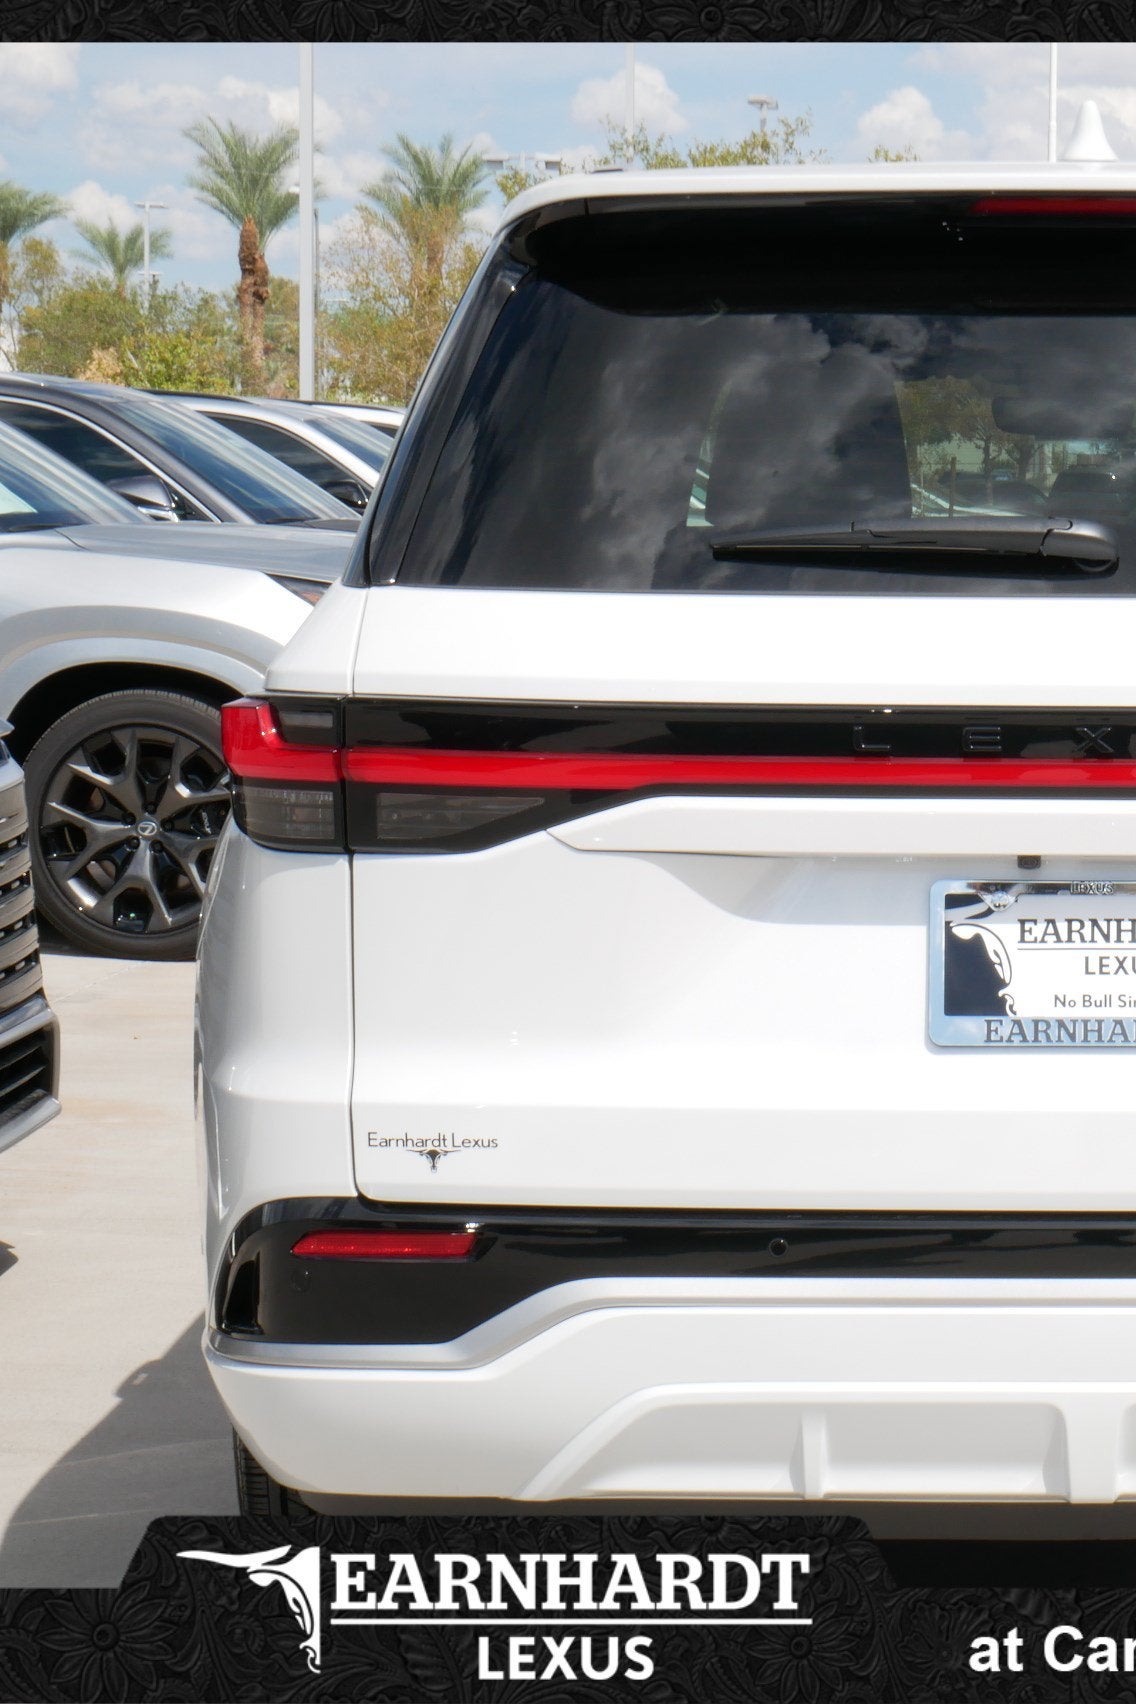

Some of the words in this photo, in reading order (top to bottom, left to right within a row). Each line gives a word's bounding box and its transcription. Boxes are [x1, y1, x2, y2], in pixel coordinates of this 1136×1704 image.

[1070, 881, 1114, 895] LEXUS
[1053, 994, 1077, 1009] No
[1082, 993, 1113, 1009] Bull
[367, 1131, 448, 1148] Earnhardt
[451, 1132, 499, 1149] Lexus
